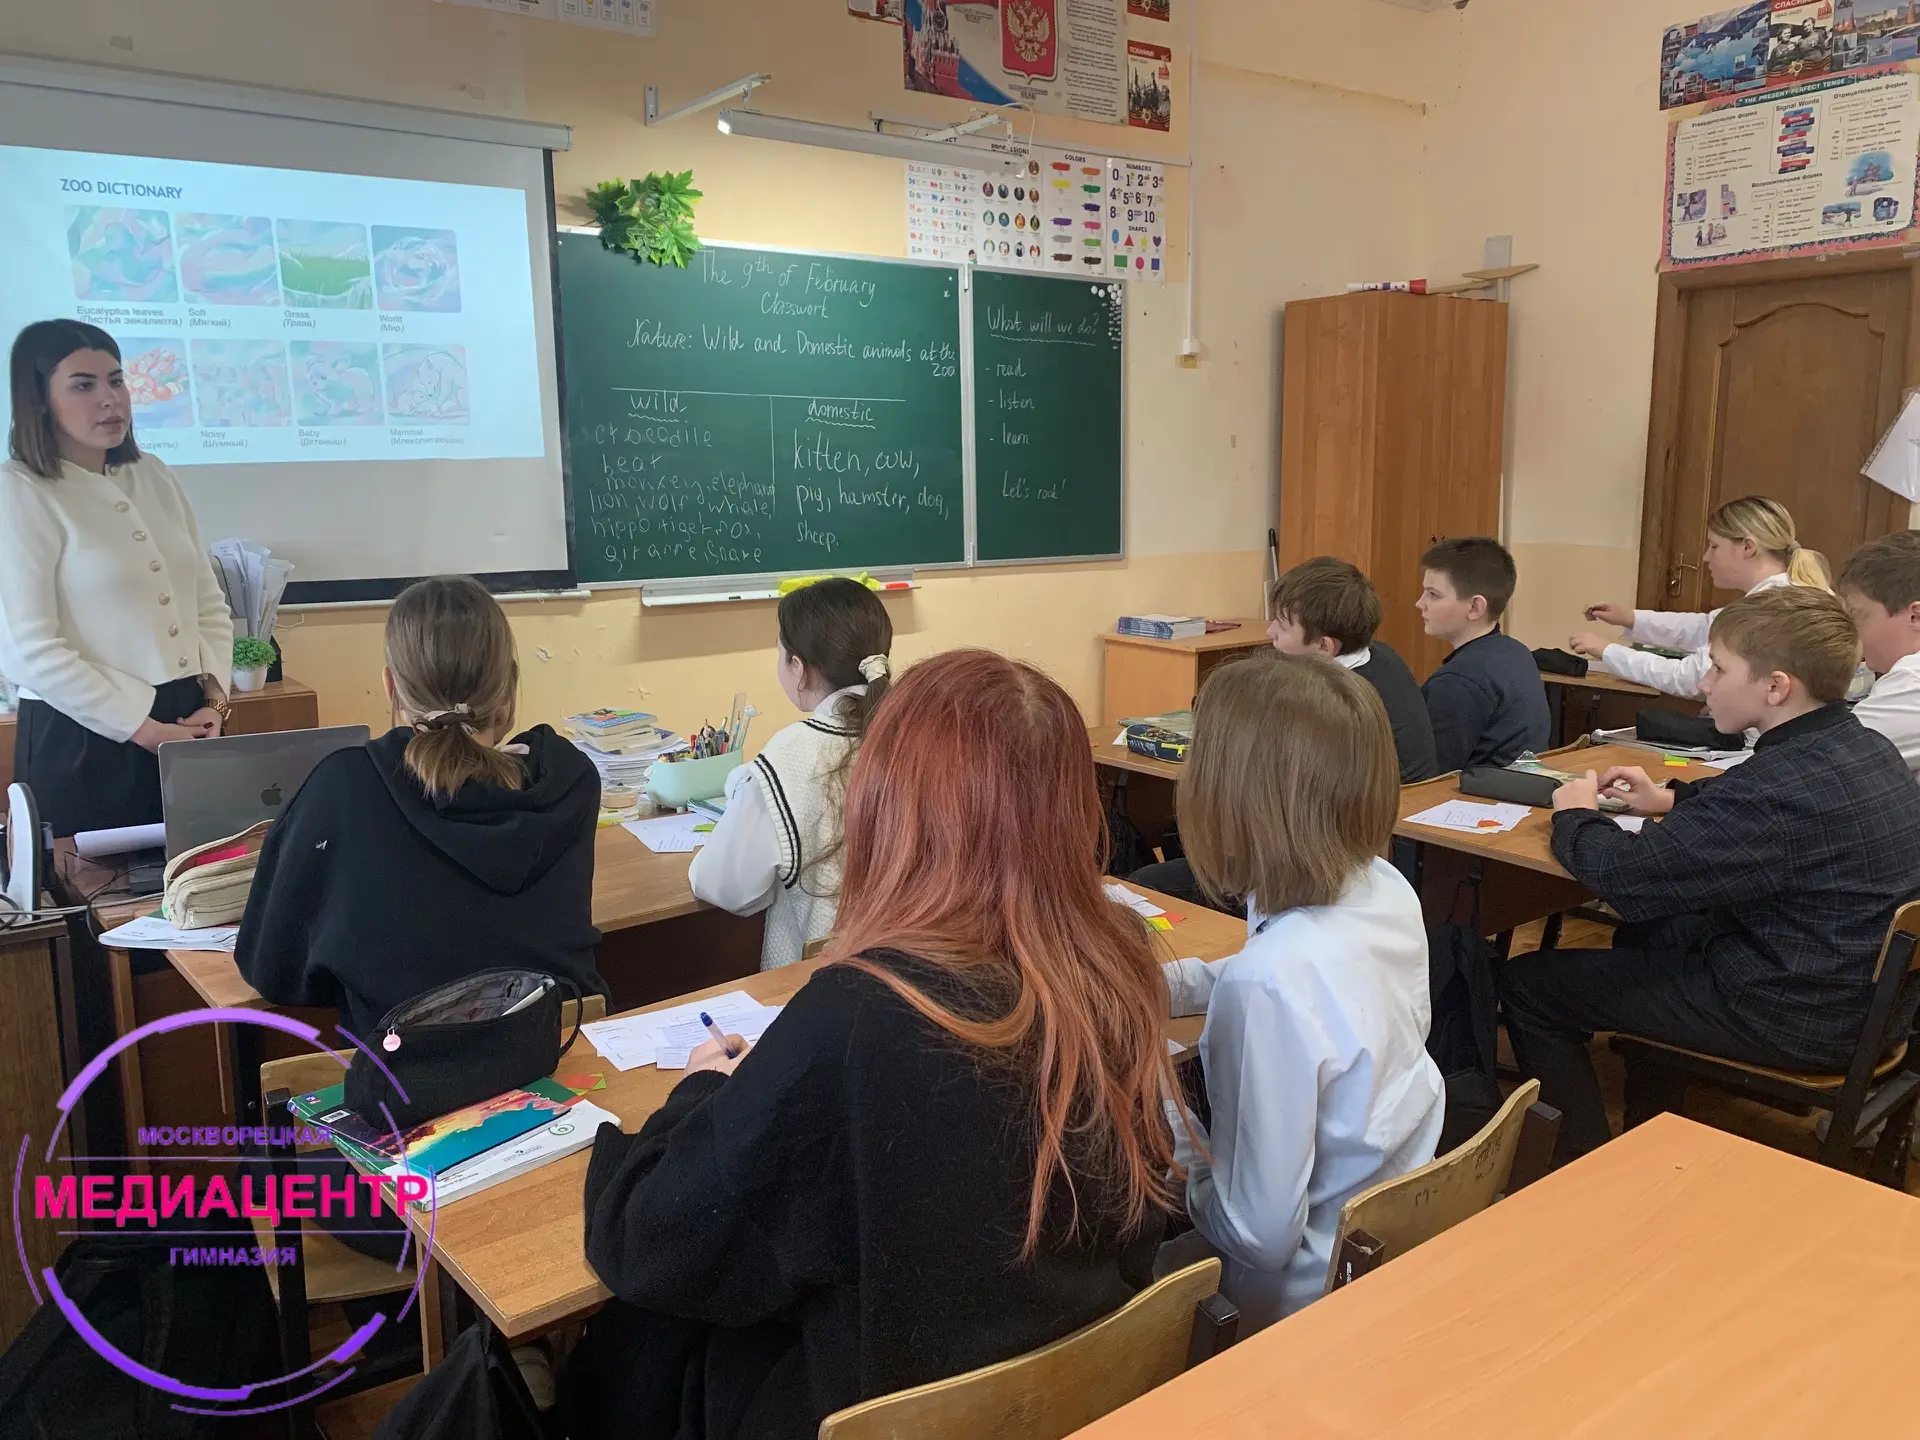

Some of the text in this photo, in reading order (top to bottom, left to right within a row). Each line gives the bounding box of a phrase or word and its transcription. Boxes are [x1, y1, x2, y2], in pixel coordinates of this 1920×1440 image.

[1745, 78, 1846, 105] THE PRESENT PERFECT TENSE
[1833, 81, 1908, 99] Отрицательная форма
[1776, 102, 1796, 112] Signal
[1798, 98, 1820, 107] Words
[1692, 111, 1758, 128] Утвердительная форма
[1065, 154, 1086, 163] COLORS
[1126, 163, 1152, 172] NUMBERS
[1112, 168, 1159, 188] 0 1 2 3
[1751, 172, 1823, 189] Вопросительная форма
[60, 178, 184, 199] ZOO DICTIONARY
[1110, 187, 1153, 207] 4 5 6 7
[1110, 206, 1155, 223] 8 9 10
[1128, 225, 1148, 233] SHAPES
[698, 249, 876, 307] The 9th of February
[76, 305, 164, 318] Eucalyptus leaves
[188, 307, 206, 317] Soft
[760, 291, 829, 319] Classwork
[284, 310, 310, 319] Grass
[379, 314, 403, 323] World
[987, 304, 1100, 336] What will we do?
[189, 318, 232, 329] (Мягкий)
[283, 319, 316, 329] (Трава)
[380, 324, 405, 333] (Мир)
[627, 318, 693, 349] Nature:
[702, 324, 745, 352] Wild
[753, 333, 788, 353] and
[797, 330, 856, 359] Domestic
[862, 339, 912, 362] animals
[996, 358, 1027, 377] read
[630, 389, 688, 413] wild
[999, 388, 1036, 410] listen
[807, 397, 875, 422] domestic
[200, 430, 226, 439] Noisy
[298, 428, 320, 438] Baby
[389, 428, 424, 437] Mammal
[1002, 423, 1029, 445] learn
[202, 439, 249, 449] (Шумный)
[794, 428, 920, 480] kitten, cow,
[602, 453, 663, 477] bear
[1002, 470, 1030, 499] Let's
[796, 477, 949, 521] pig, hamster, dog,
